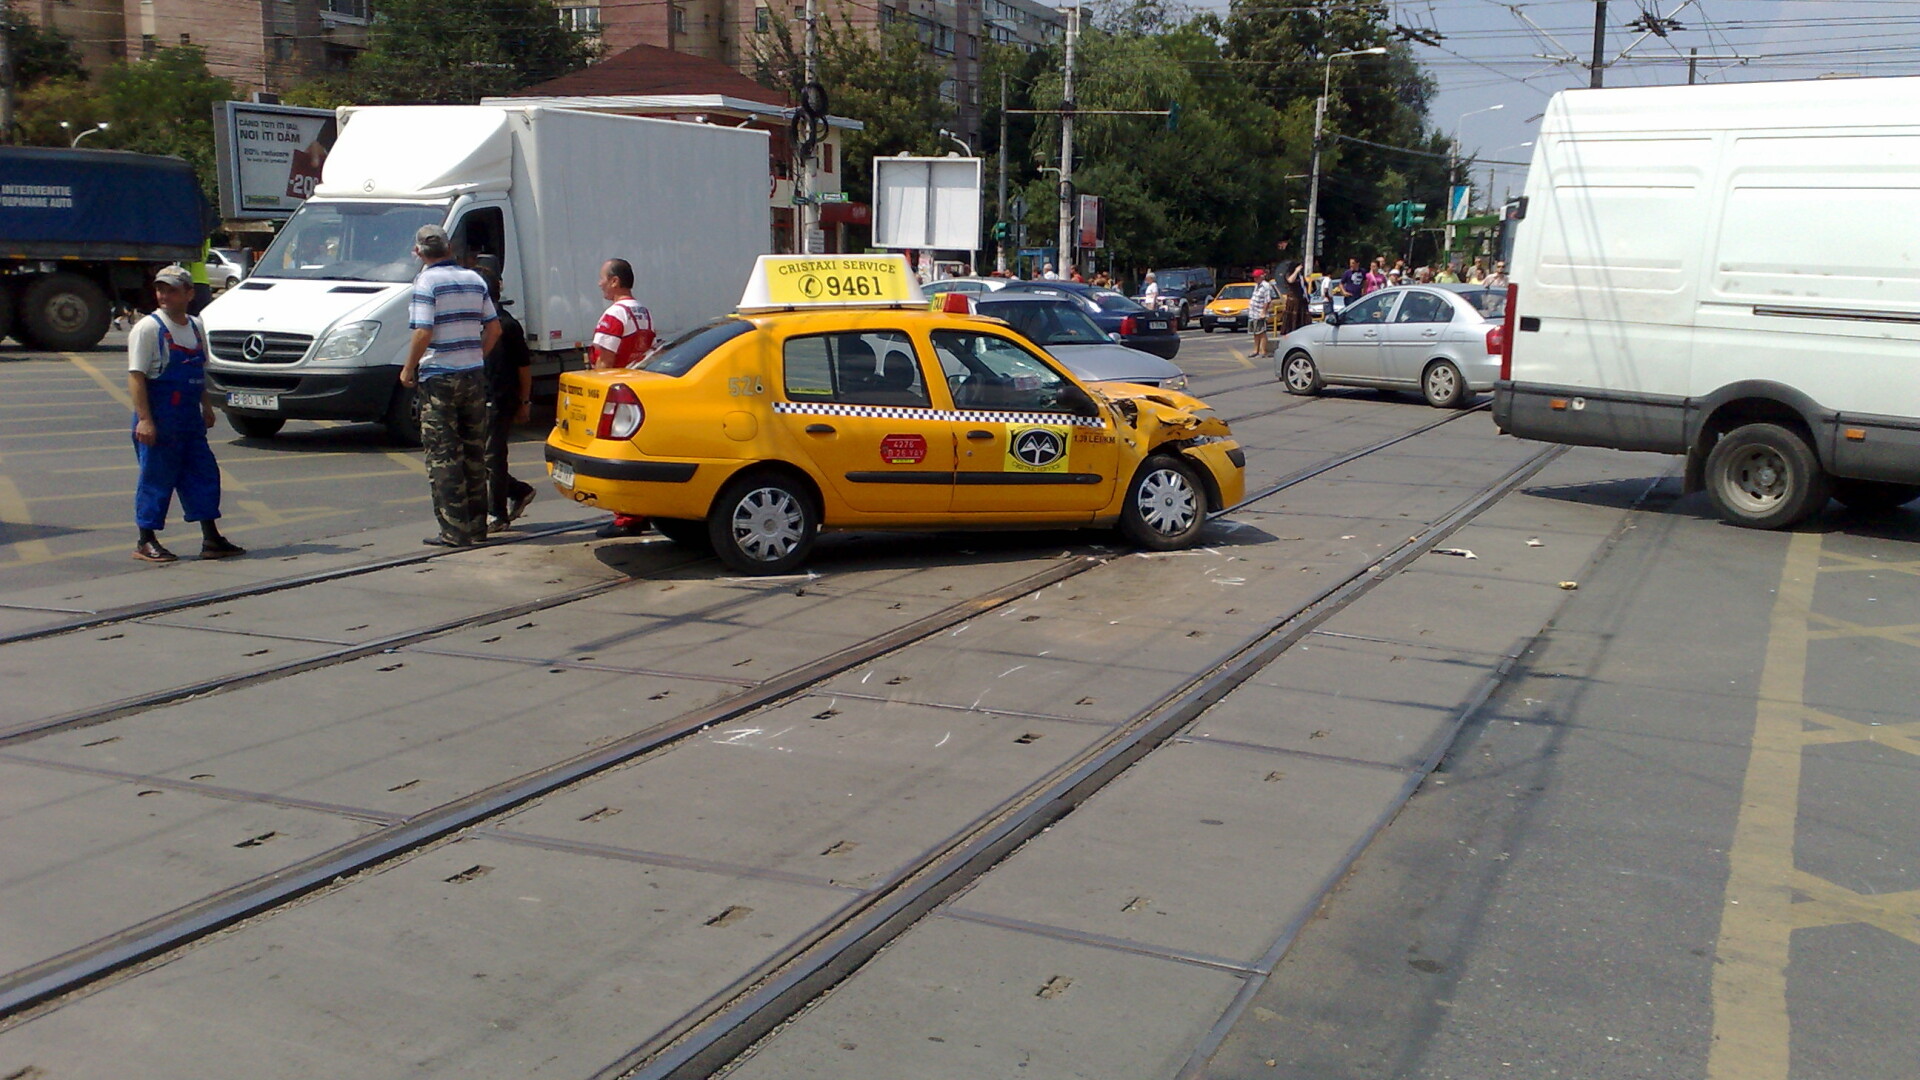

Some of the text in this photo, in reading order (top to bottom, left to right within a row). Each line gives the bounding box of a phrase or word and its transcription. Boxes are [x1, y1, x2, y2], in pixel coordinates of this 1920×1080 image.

[240, 130, 259, 140] NOI
[50, 198, 73, 208] AUTO
[778, 260, 896, 275] CRISTAXI SERVICE
[826, 276, 883, 297] 9461
[728, 376, 764, 397] 526
[233, 394, 240, 405] B
[893, 440, 914, 449] 4276
